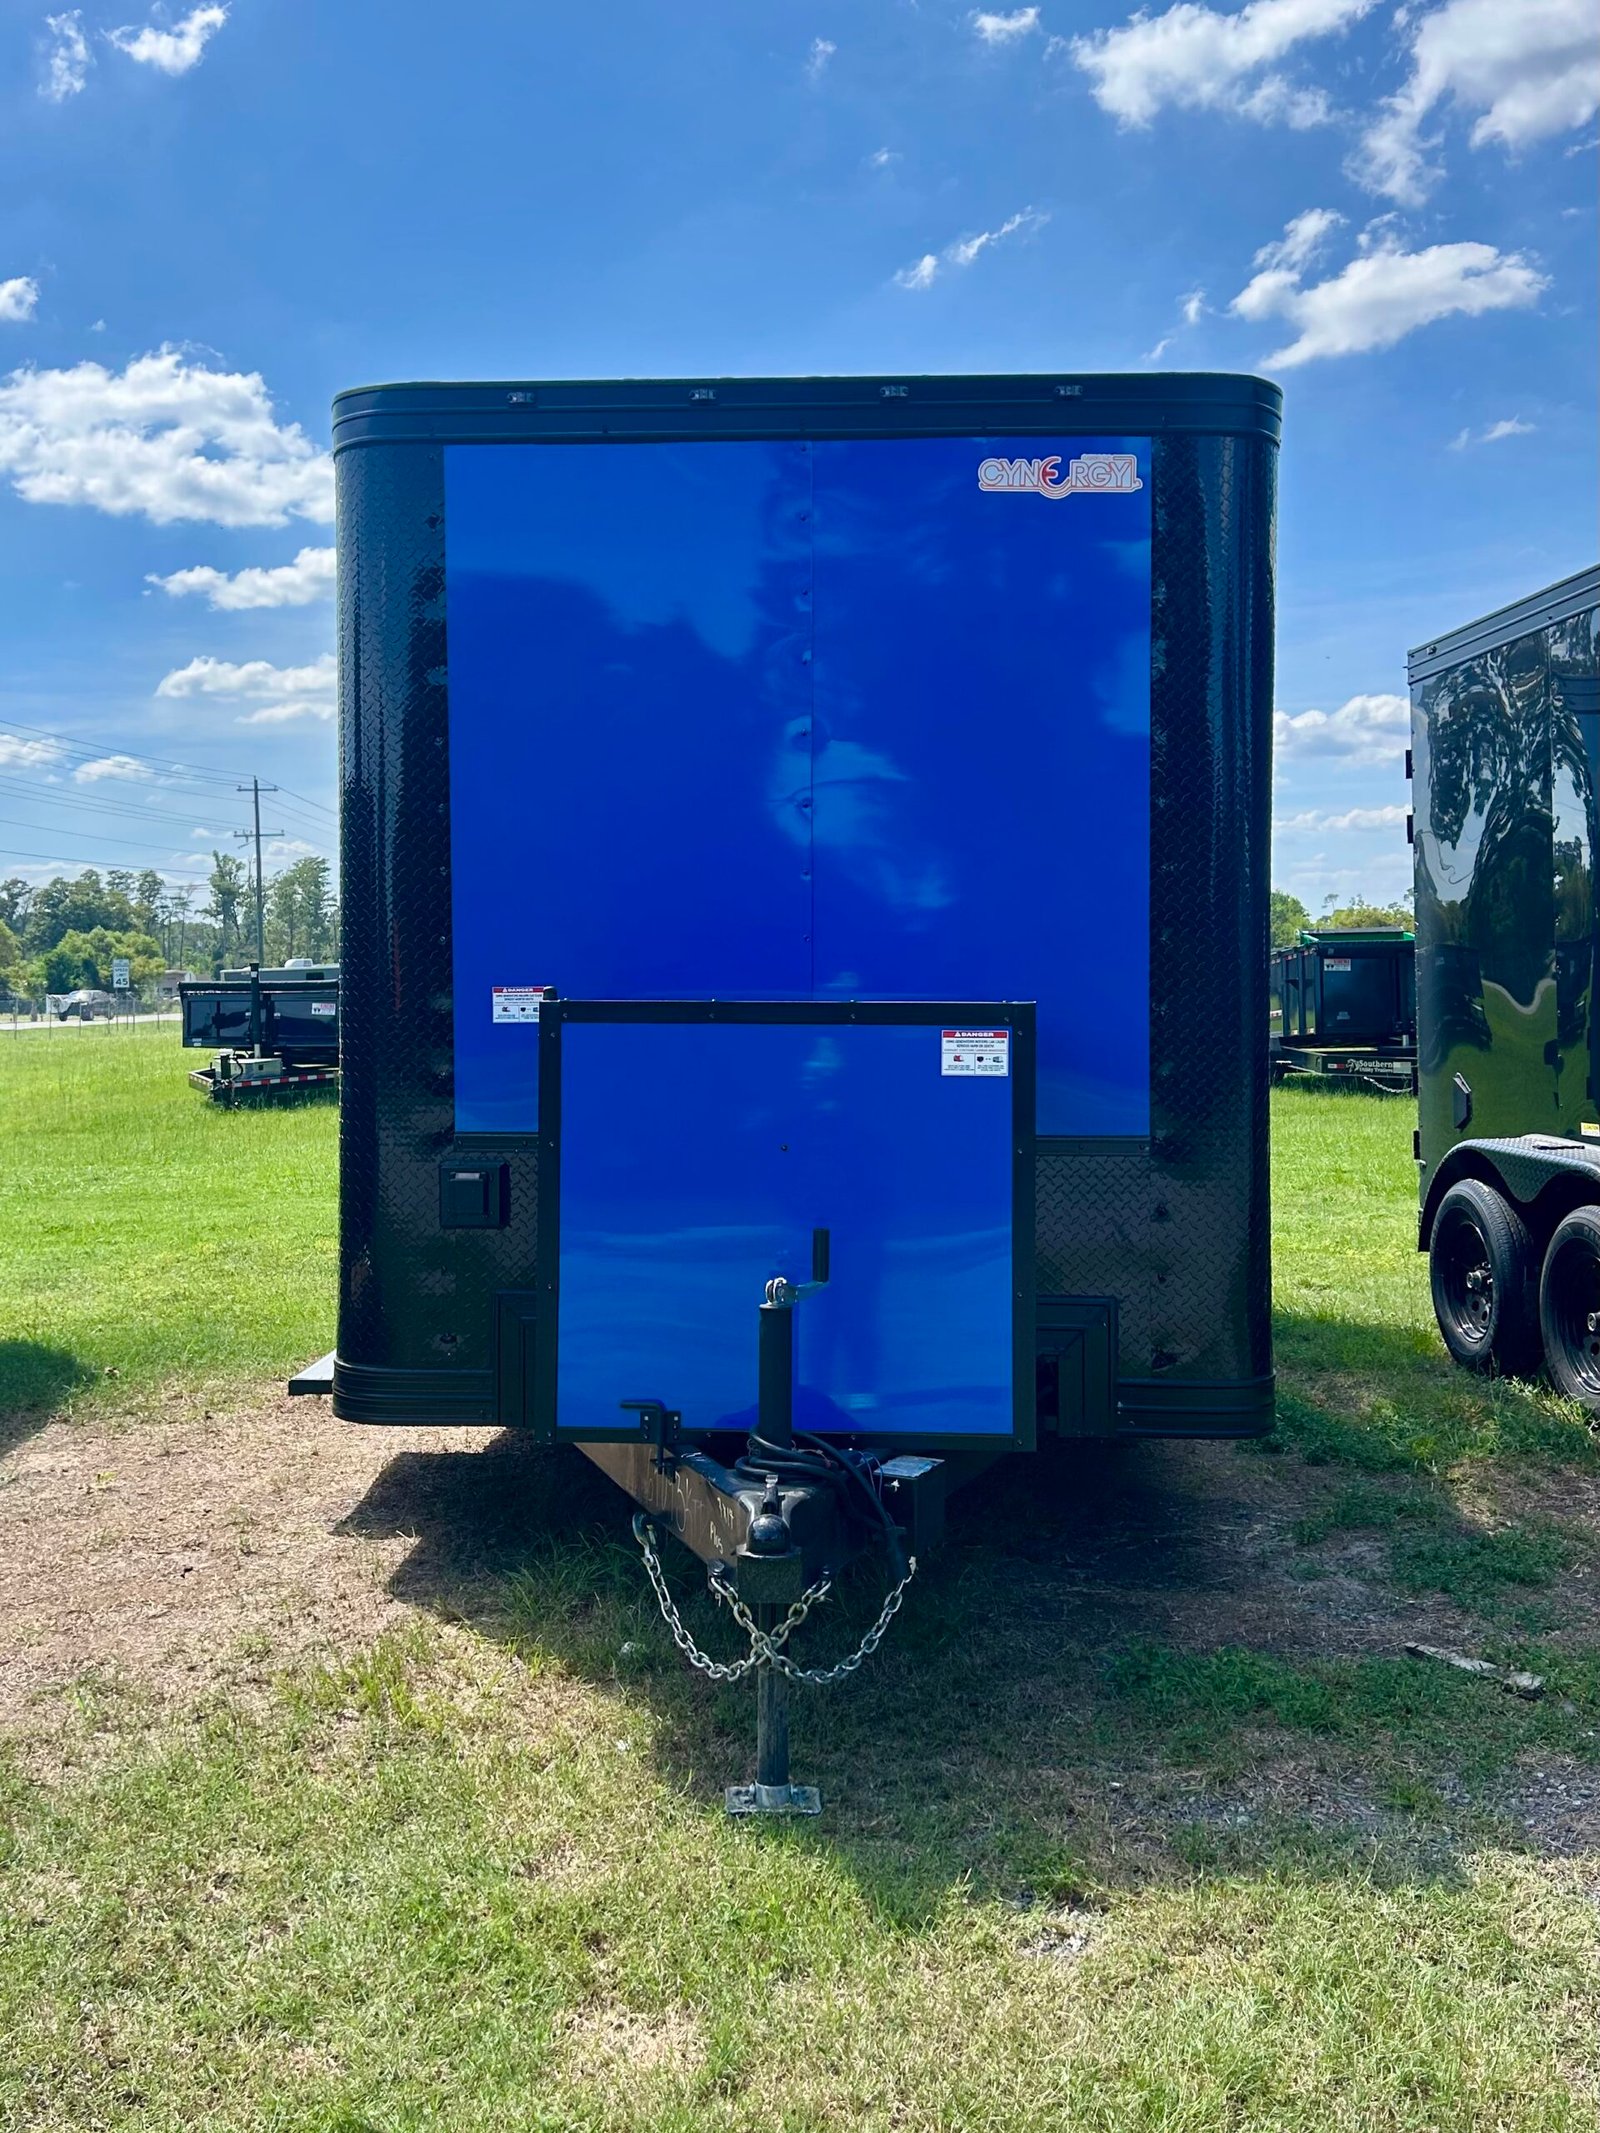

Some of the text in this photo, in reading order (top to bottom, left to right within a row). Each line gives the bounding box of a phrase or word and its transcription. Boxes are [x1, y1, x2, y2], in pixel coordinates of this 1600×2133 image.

[980, 457, 1133, 490] CYNERGY
[115, 978, 128, 986] 45
[1359, 1060, 1393, 1068] Southern
